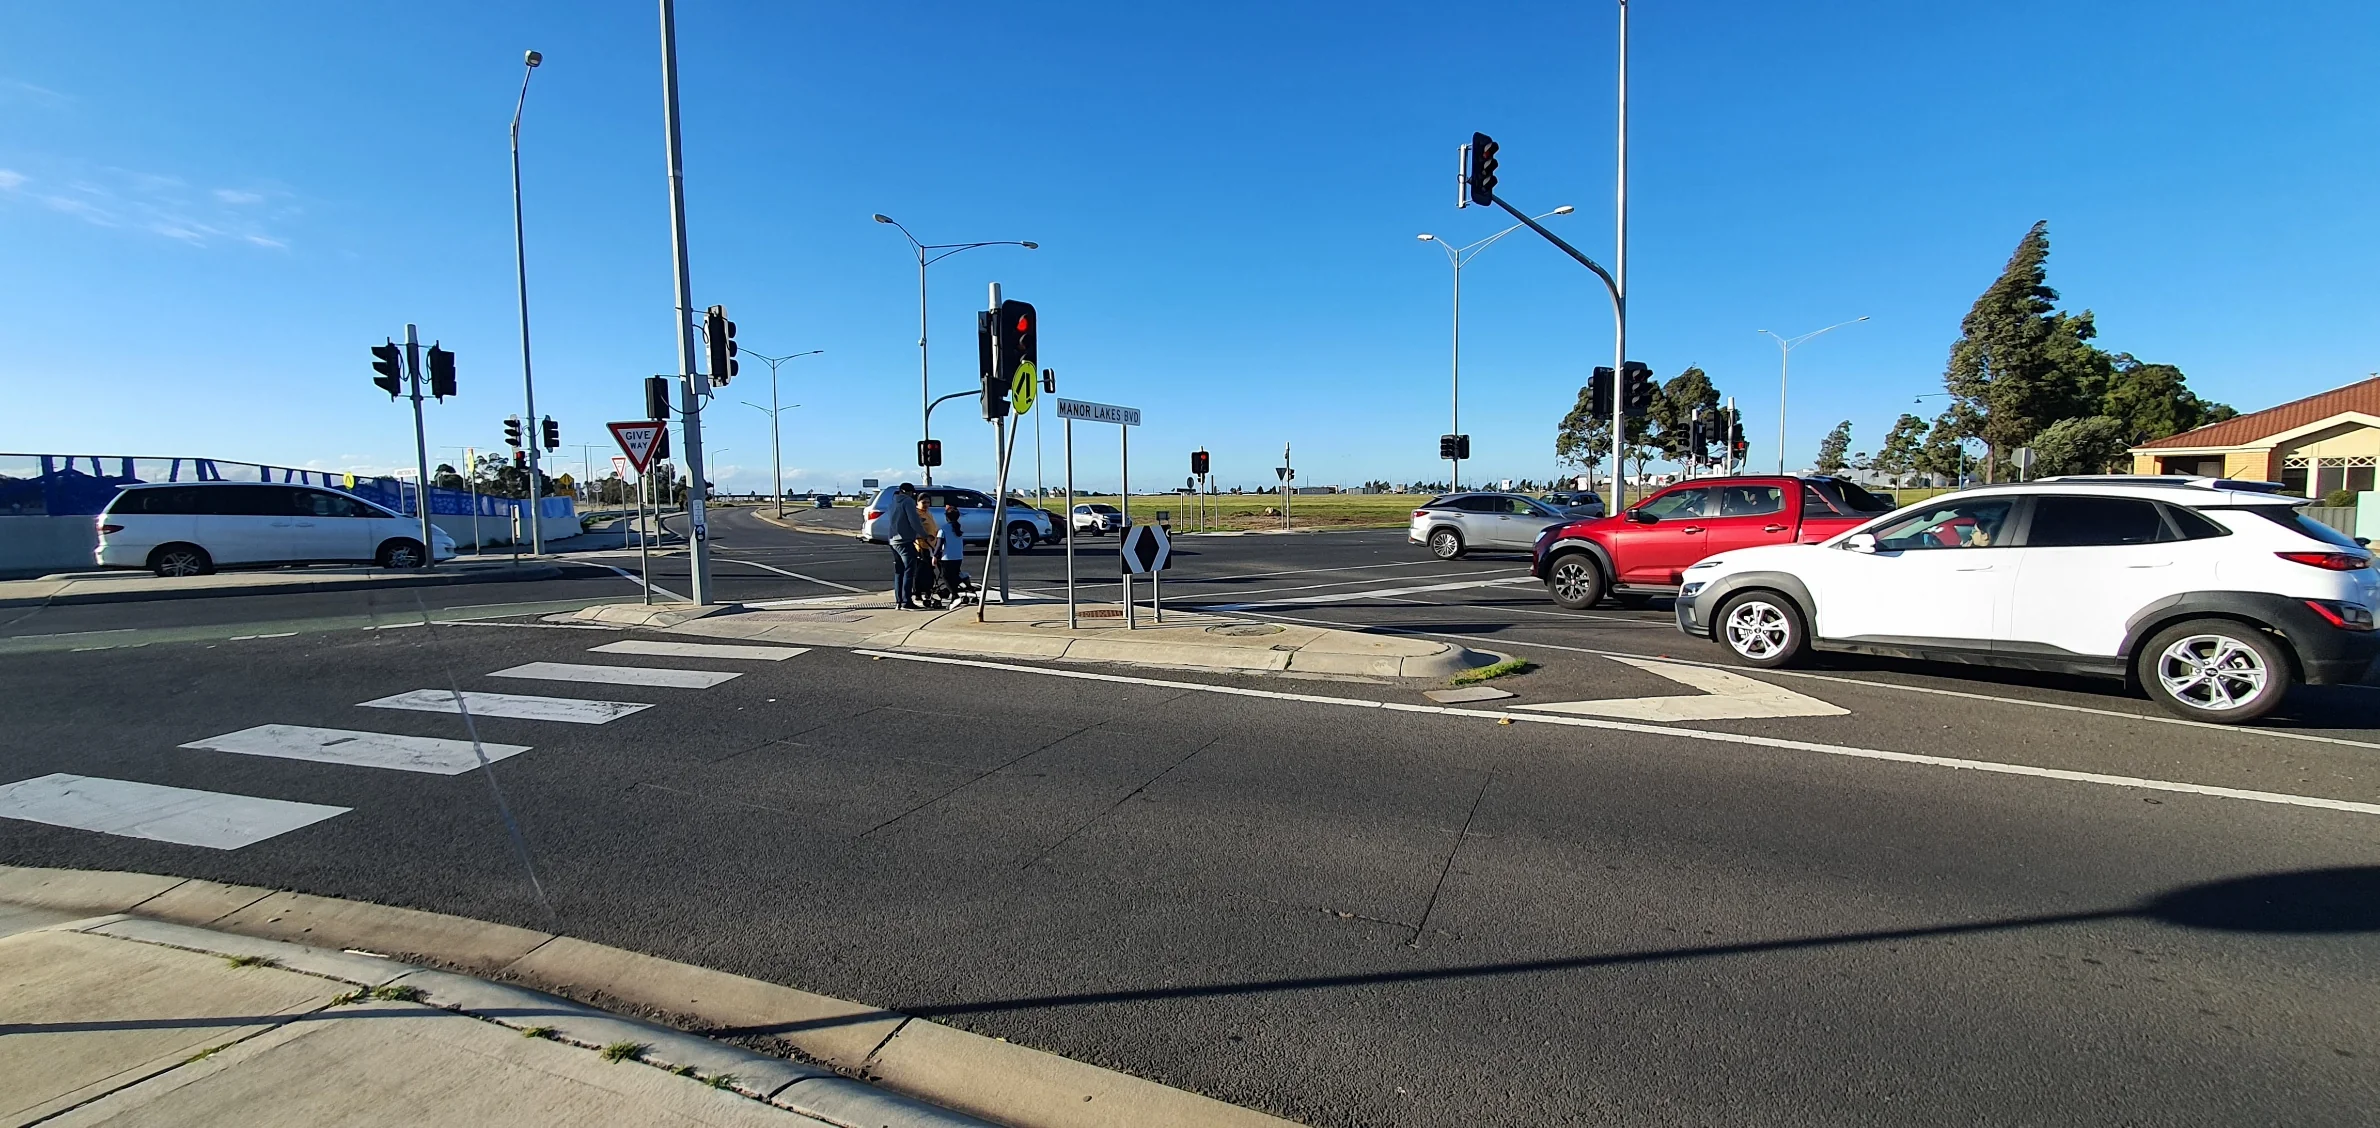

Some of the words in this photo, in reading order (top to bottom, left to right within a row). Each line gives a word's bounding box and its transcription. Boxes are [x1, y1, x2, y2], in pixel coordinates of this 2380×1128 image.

[1060, 401, 1091, 418] MANOR
[1094, 406, 1121, 421] LAKES
[1124, 410, 1139, 423] BVD
[625, 430, 651, 440] GIVE
[630, 442, 648, 450] WAY
